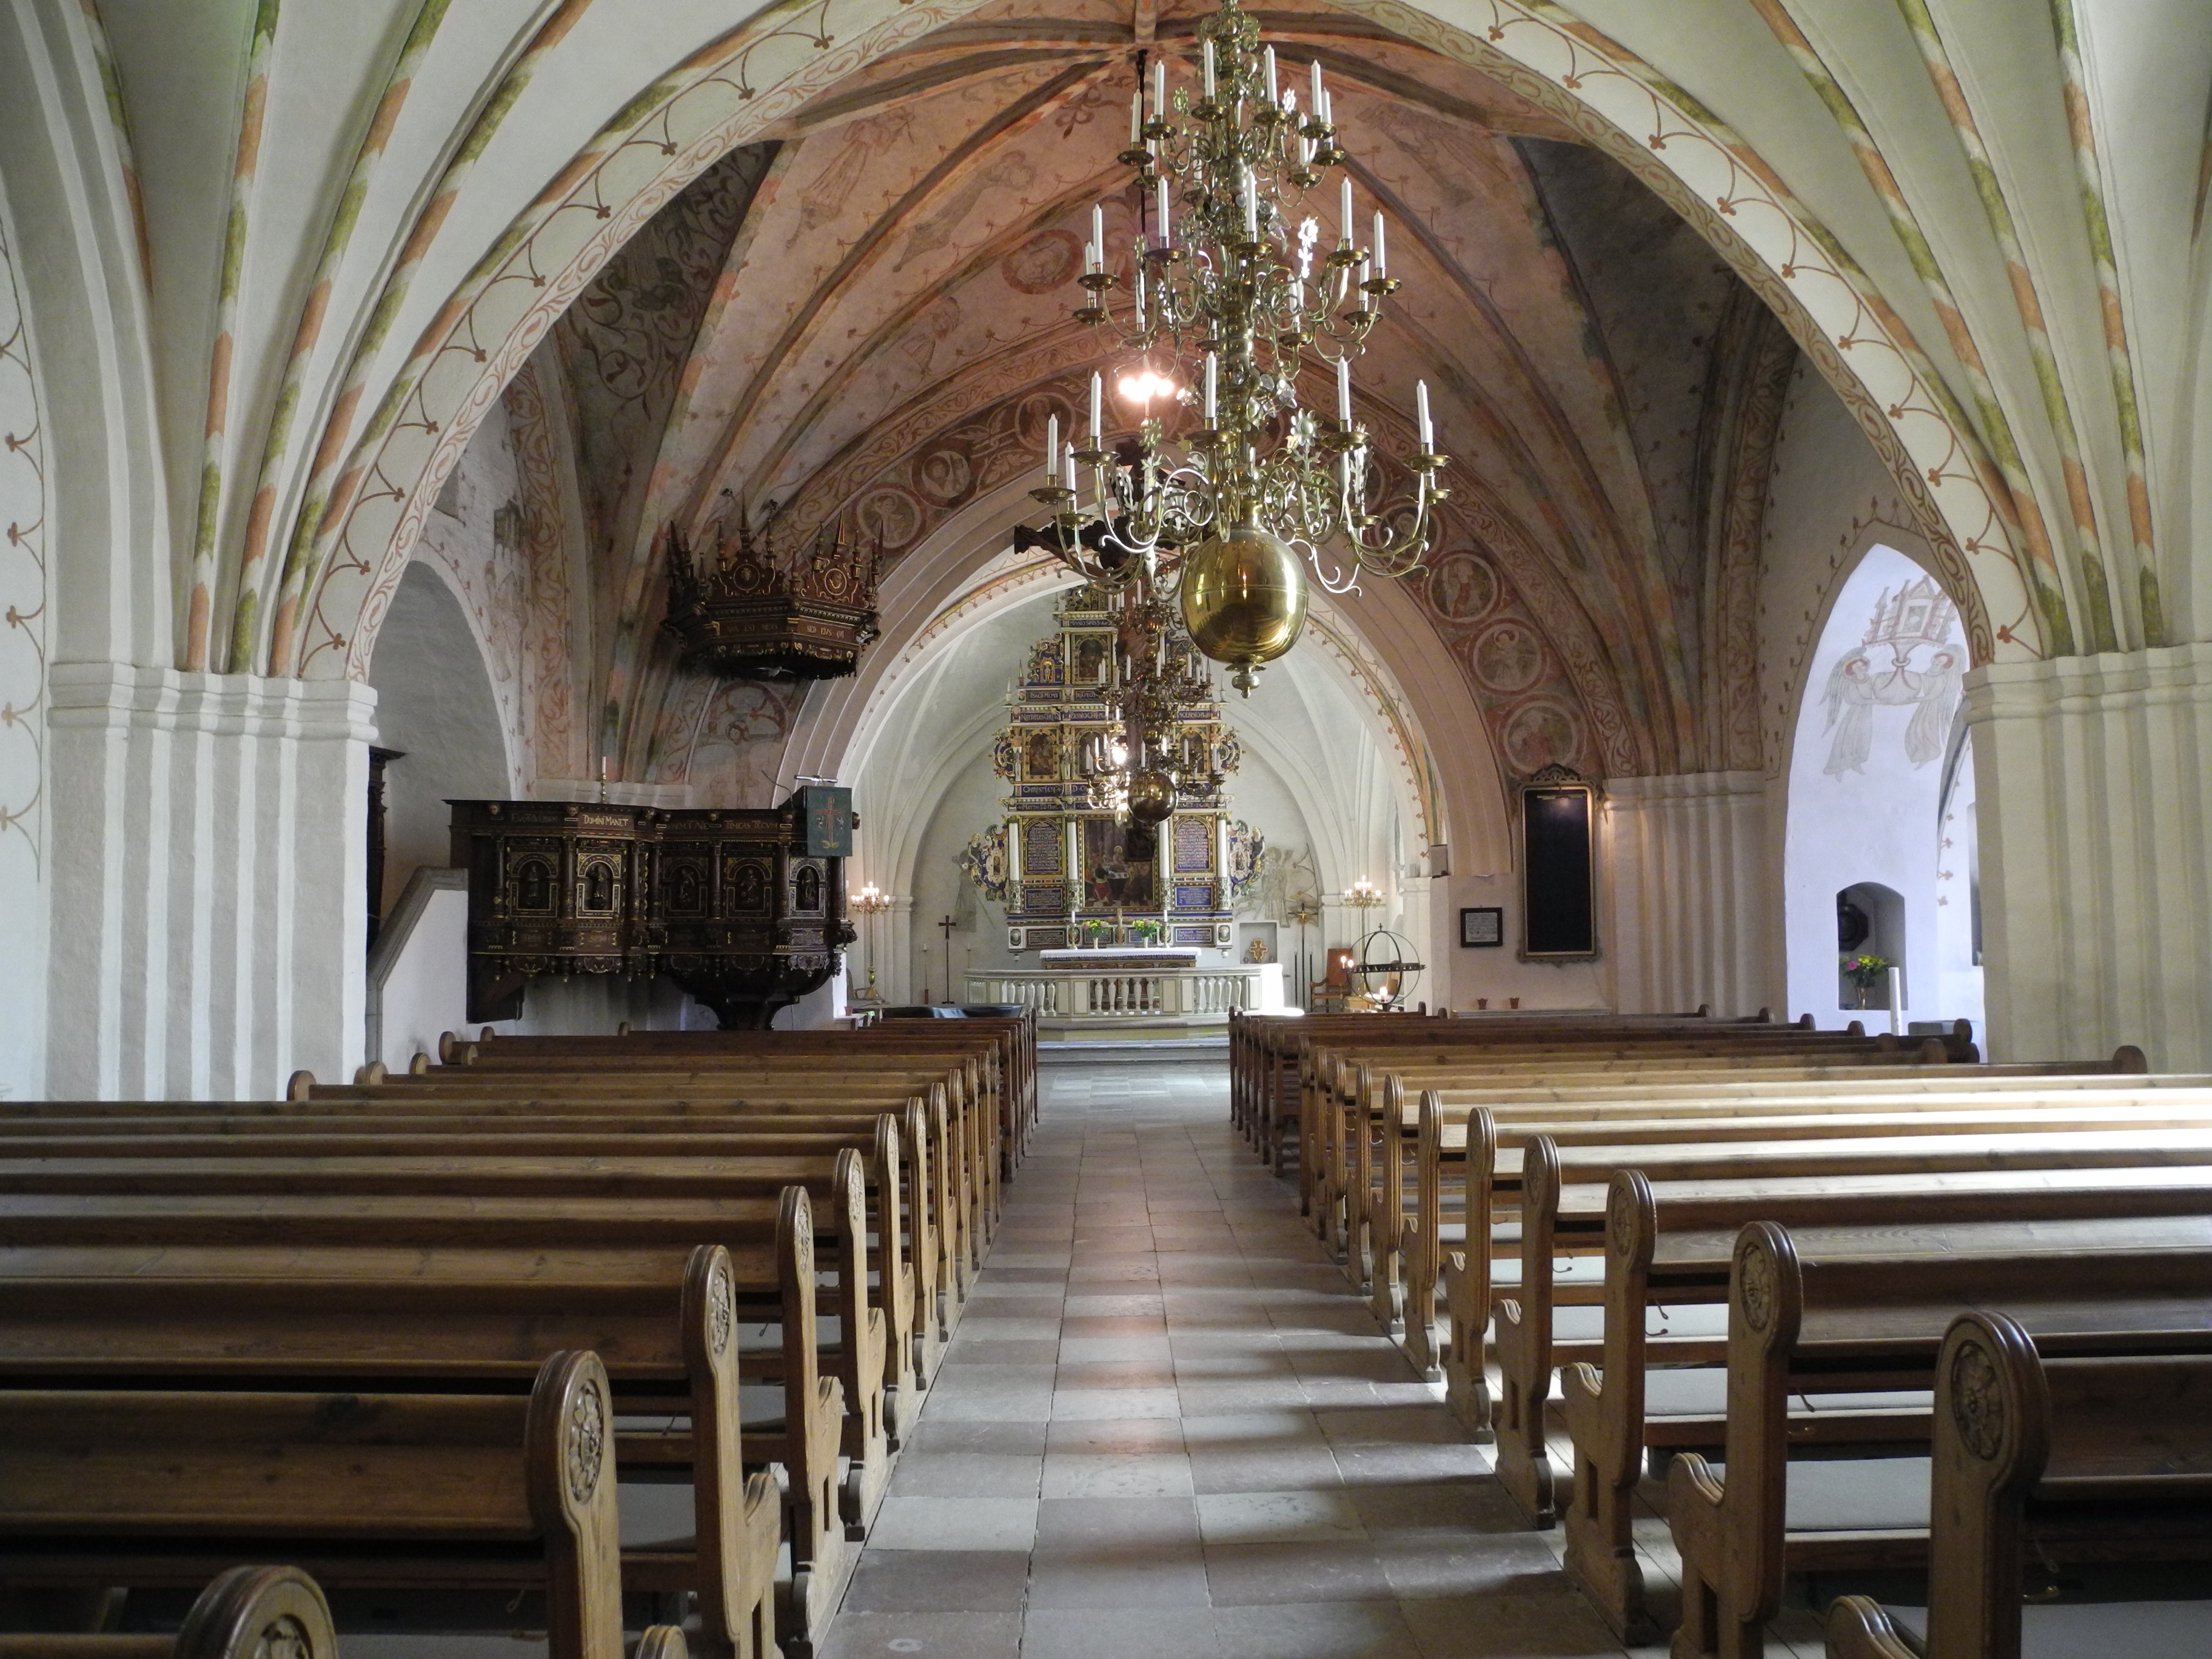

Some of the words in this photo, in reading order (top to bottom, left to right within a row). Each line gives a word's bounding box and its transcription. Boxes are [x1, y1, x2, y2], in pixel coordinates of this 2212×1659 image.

[806, 625, 817, 634] SED
[582, 814, 605, 825] DOMINI
[605, 815, 629, 827] MANET
[751, 820, 778, 830] TECVM
